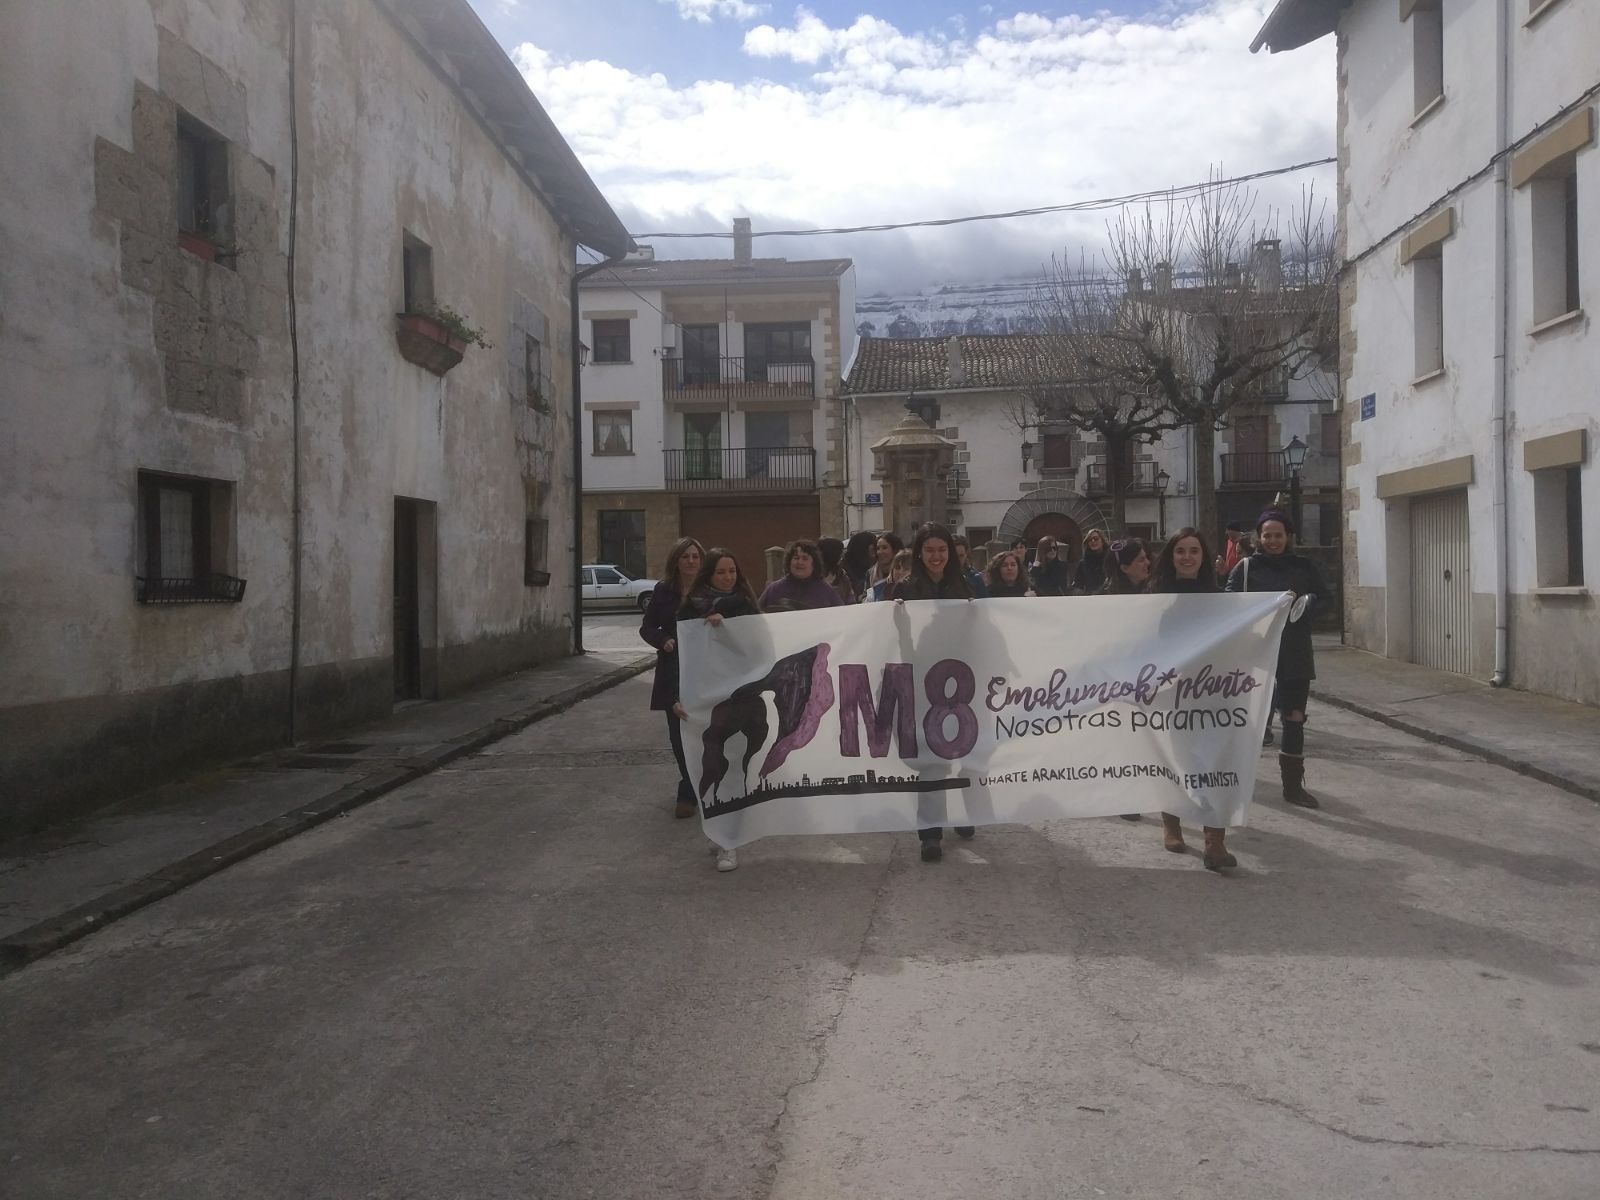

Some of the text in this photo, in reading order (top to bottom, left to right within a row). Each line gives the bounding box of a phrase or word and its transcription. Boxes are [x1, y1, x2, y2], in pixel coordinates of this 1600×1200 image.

[838, 658, 979, 760] M8
[995, 706, 1249, 740] Nosotras paramos
[978, 764, 1239, 790] UHARTE ARAKILGO MUGIMENDU FEMINISTA
